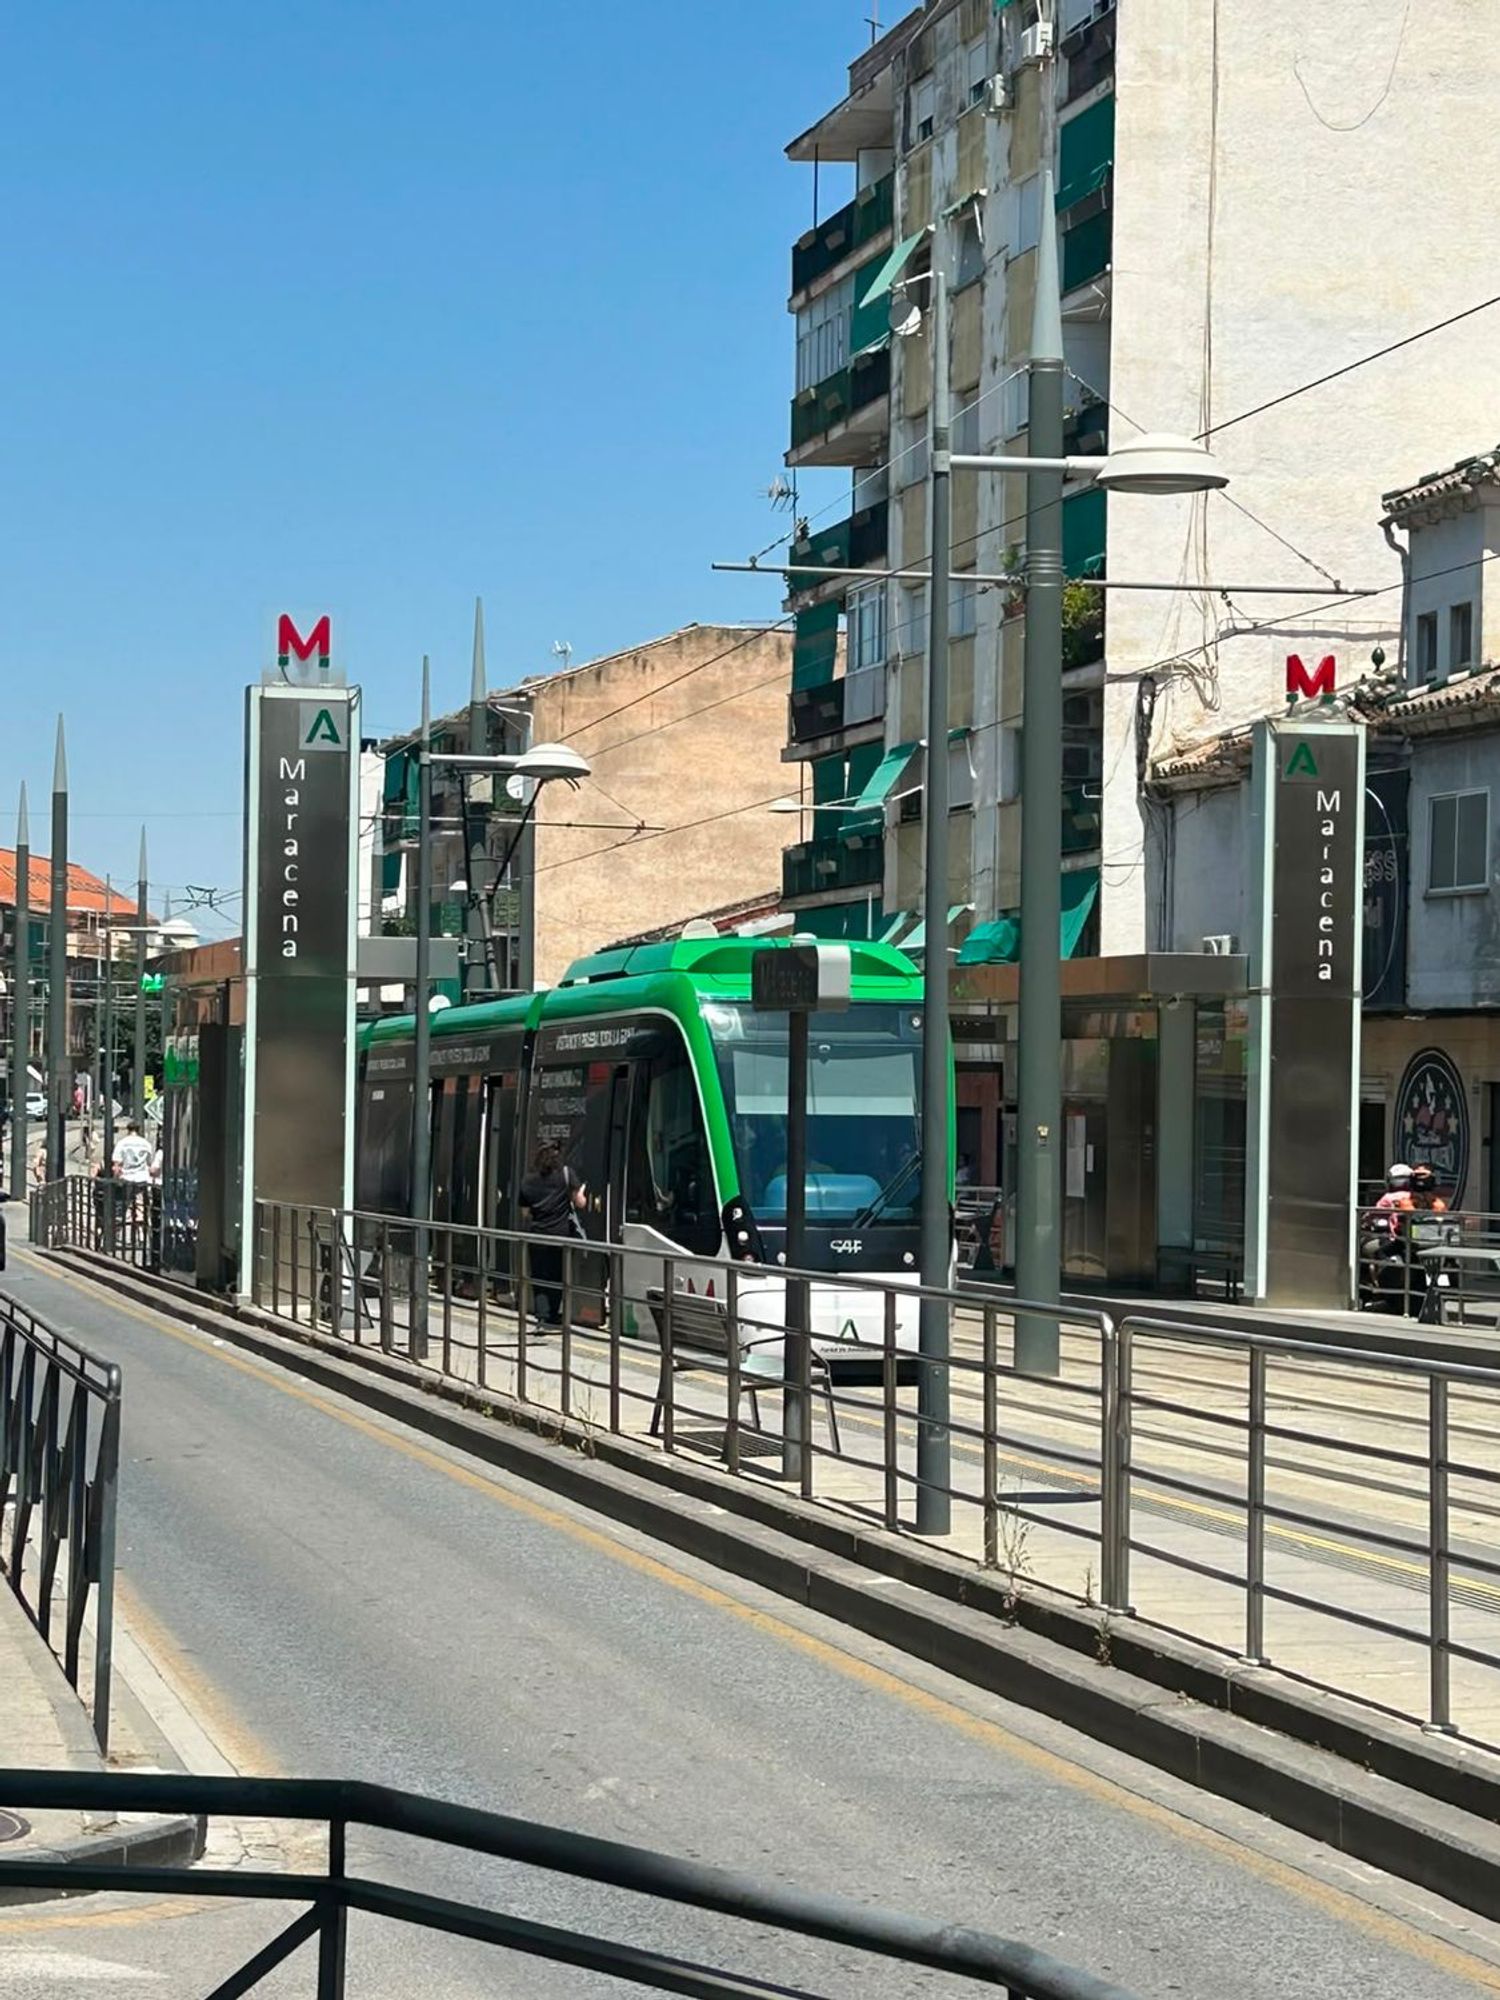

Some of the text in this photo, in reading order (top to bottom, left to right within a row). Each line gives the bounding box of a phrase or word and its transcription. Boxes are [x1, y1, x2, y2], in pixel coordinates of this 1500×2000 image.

[278, 613, 330, 666] M
[1286, 654, 1336, 703] M
[278, 757, 306, 958] Maracena
[1315, 789, 1341, 981] Maracena
